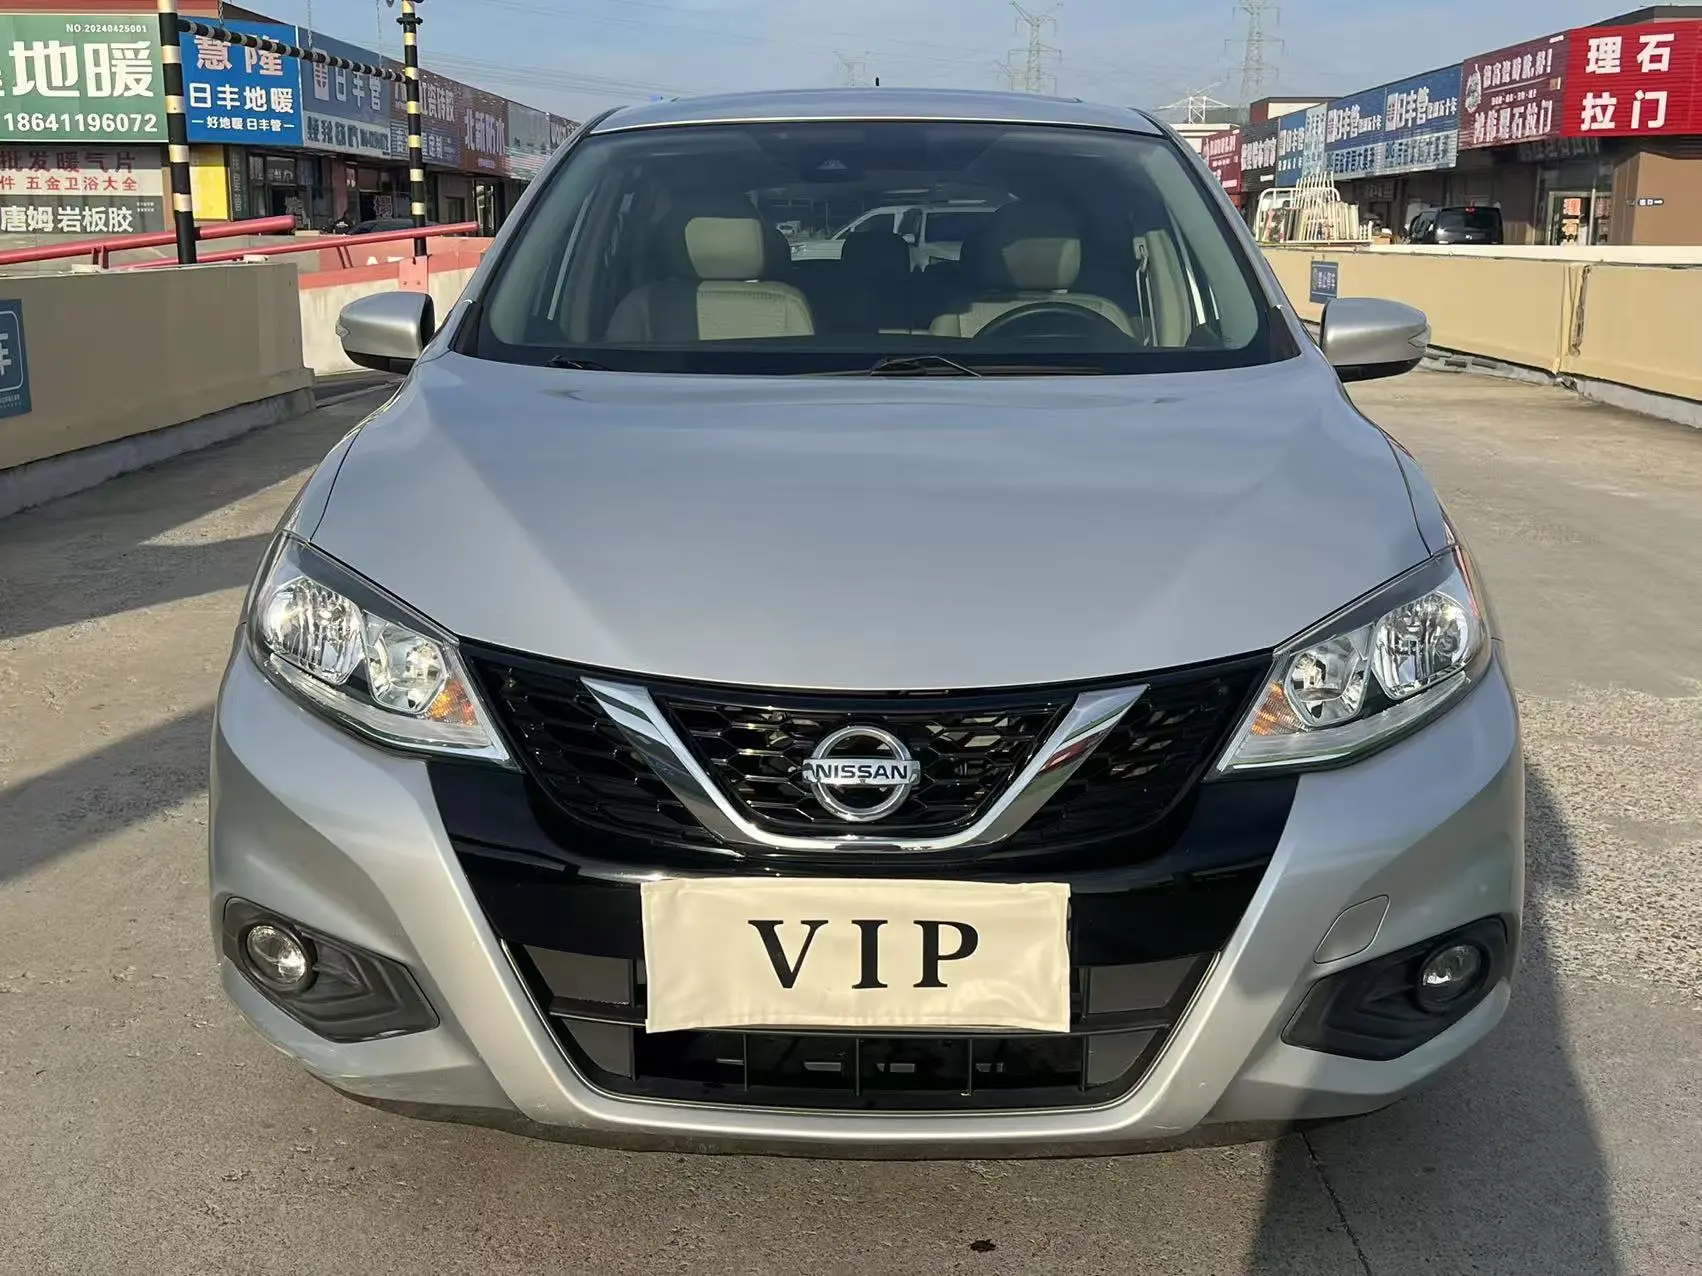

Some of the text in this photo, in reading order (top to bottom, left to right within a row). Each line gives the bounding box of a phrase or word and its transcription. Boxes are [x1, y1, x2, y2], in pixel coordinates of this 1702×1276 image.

[65, 23, 148, 33] NO.20240425001
[1585, 33, 1675, 74] 理石
[0, 40, 154, 97] 地暖
[189, 82, 294, 114] 日丰地暖
[1396, 87, 1429, 128] 日丰管
[1580, 89, 1668, 131] 拉门
[3, 112, 158, 132] 18641196072
[206, 116, 282, 132] 好地暖 日丰管
[1335, 104, 1361, 140] 日丰管
[0, 151, 136, 173] 批发暖气片
[26, 176, 137, 191] 五金卫浴大全
[0, 206, 134, 232] 唐姆岩板胶
[815, 764, 908, 780] NISSAN
[748, 919, 979, 989] VIP
